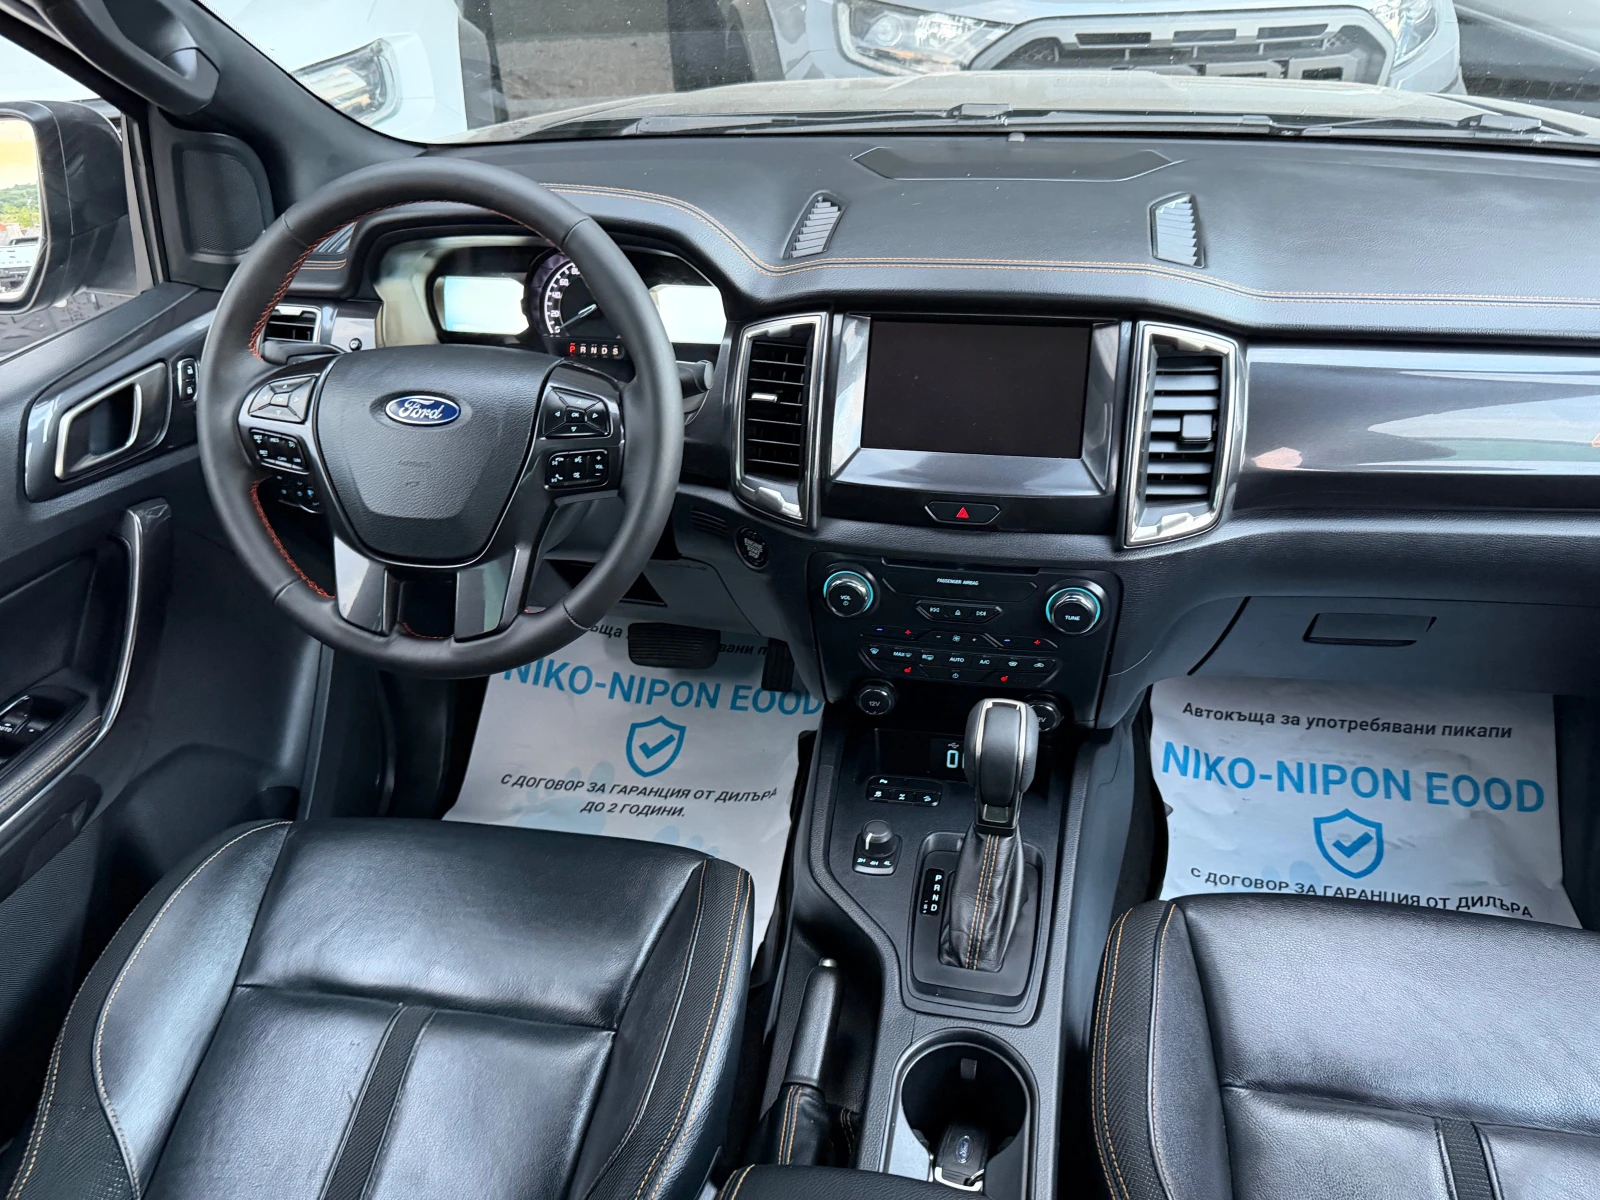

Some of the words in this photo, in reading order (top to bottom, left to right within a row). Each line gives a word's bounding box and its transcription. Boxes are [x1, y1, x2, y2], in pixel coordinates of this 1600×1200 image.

[550, 309, 560, 317] 20
[569, 345, 576, 353] P
[580, 346, 587, 354] R
[590, 346, 598, 354] N
[601, 347, 608, 355] D
[612, 347, 619, 355] S
[399, 398, 443, 419] Ford
[936, 577, 962, 585] PASSENGER
[504, 658, 721, 709] NIKO-NIPON
[868, 700, 881, 708] 12V
[1182, 702, 1275, 725] Автокъща
[1280, 713, 1300, 726] за
[1305, 716, 1436, 735] употребявани
[1441, 724, 1512, 739] пикапи
[1161, 741, 1411, 802] NIKO-NIPON
[1426, 772, 1544, 813] EOOD
[513, 775, 585, 793] ДОГОВОР
[586, 782, 606, 794] ЗА
[608, 784, 690, 800] ГАРАНЦИЯ
[693, 789, 714, 800] ОТ
[715, 787, 777, 803] ДИЛЪРА
[580, 801, 605, 813] ДО
[607, 803, 618, 813] 2
[619, 804, 685, 817] ГОДИНИ.
[935, 874, 942, 882] P
[933, 884, 941, 892] R
[1204, 871, 1290, 892] ДОГОВОР
[1294, 882, 1317, 895] ЗА
[1426, 896, 1451, 909] ОТ
[1456, 895, 1534, 918] ДИЛЪРА
[930, 904, 938, 912] D
